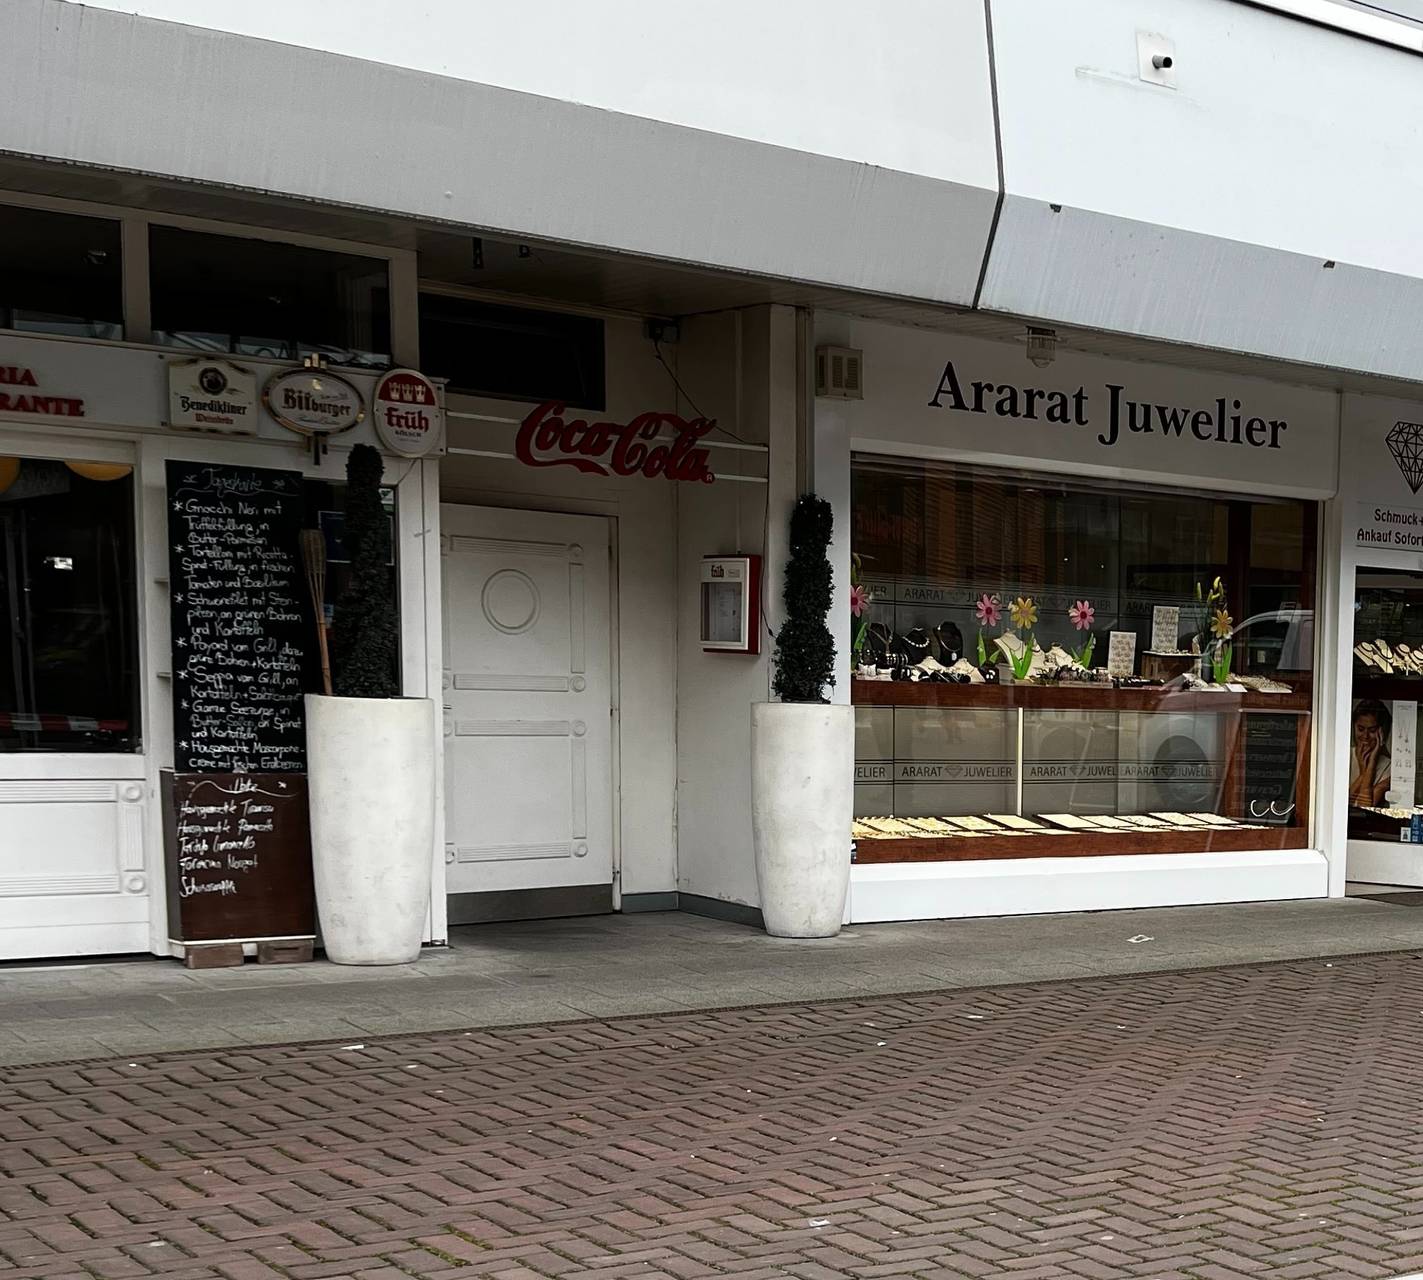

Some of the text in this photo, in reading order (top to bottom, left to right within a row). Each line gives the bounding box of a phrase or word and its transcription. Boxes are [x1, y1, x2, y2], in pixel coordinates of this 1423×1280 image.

[282, 387, 351, 418] Bitburger
[927, 360, 1287, 449] Ararat Juwelier
[1356, 528, 1392, 543] Ankauf
[901, 766, 1013, 778] ARARAT JUWELIER
[1030, 766, 1067, 777] ARARAT
